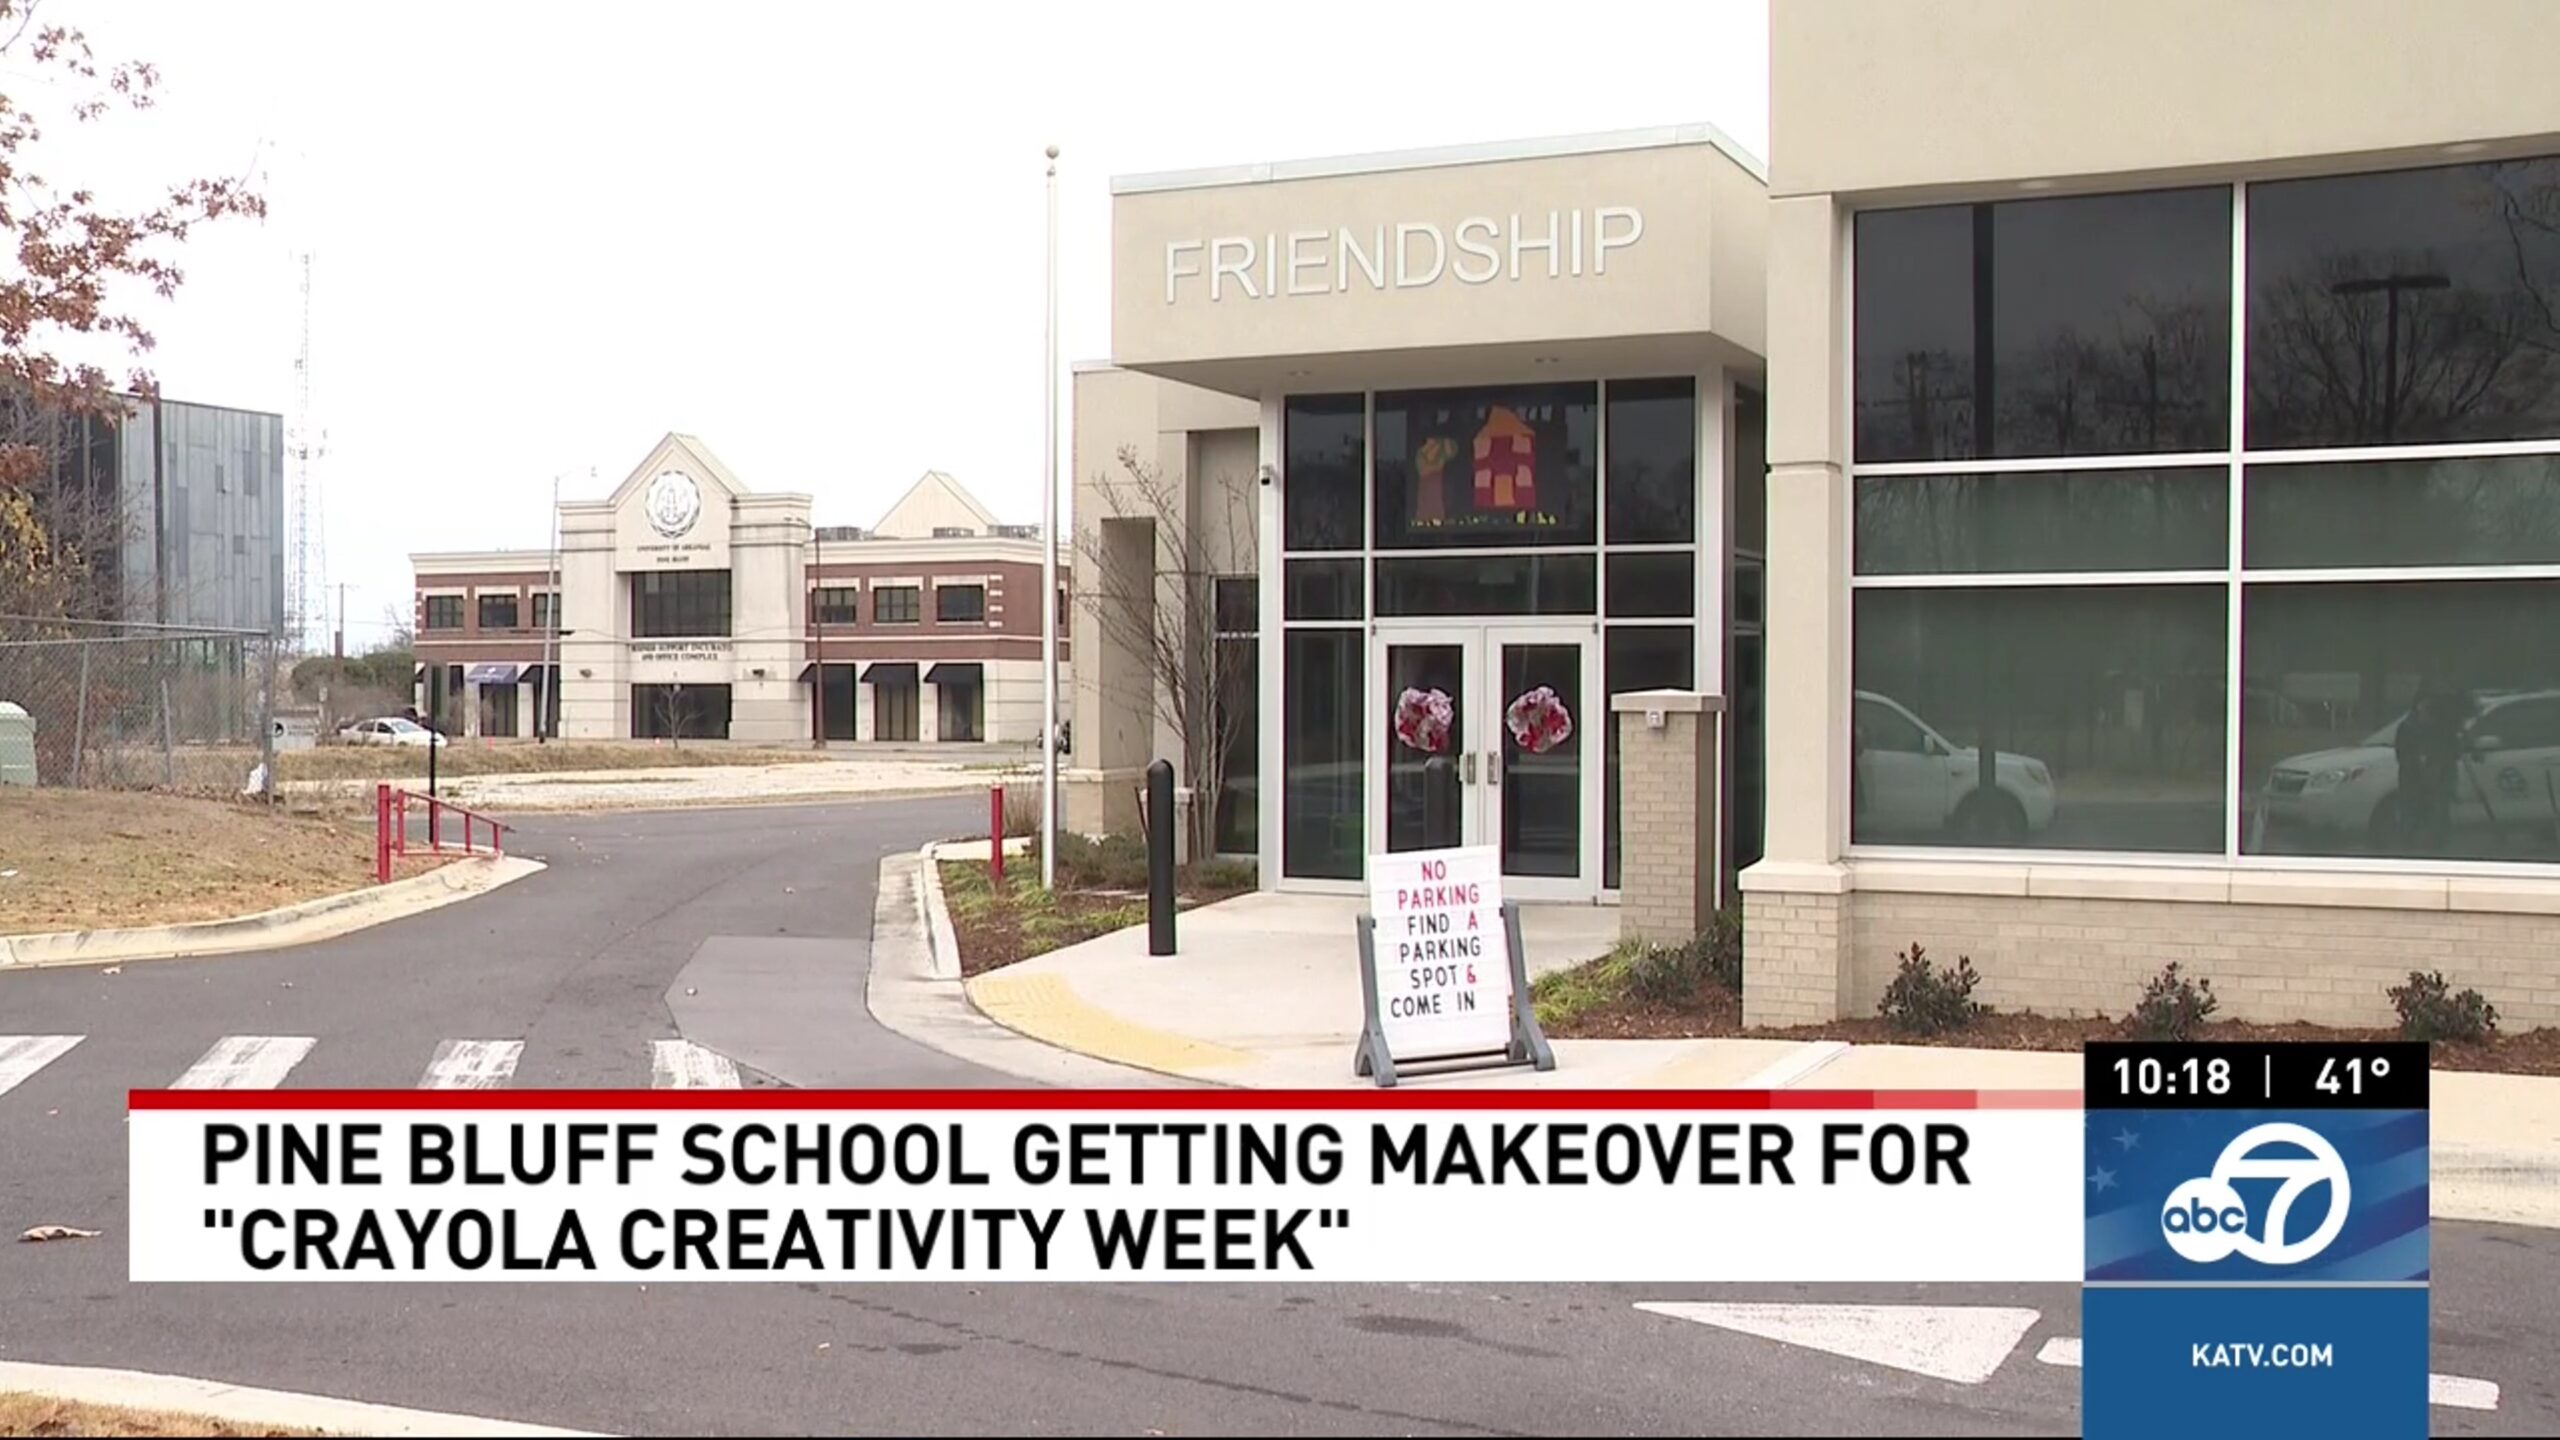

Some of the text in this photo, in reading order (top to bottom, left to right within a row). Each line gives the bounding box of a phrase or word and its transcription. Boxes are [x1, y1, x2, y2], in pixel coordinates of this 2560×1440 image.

[1164, 206, 1644, 304] FRIENDSHIP
[656, 653, 679, 661] OFFICE
[681, 653, 718, 661] COMPLEX
[1421, 859, 1446, 881] NO
[1398, 883, 1480, 910] PARKING
[1408, 910, 1479, 936] FIND A
[1399, 936, 1481, 964] PARKING
[1410, 965, 1457, 989] SPOT
[1390, 991, 1476, 1018] COME IN
